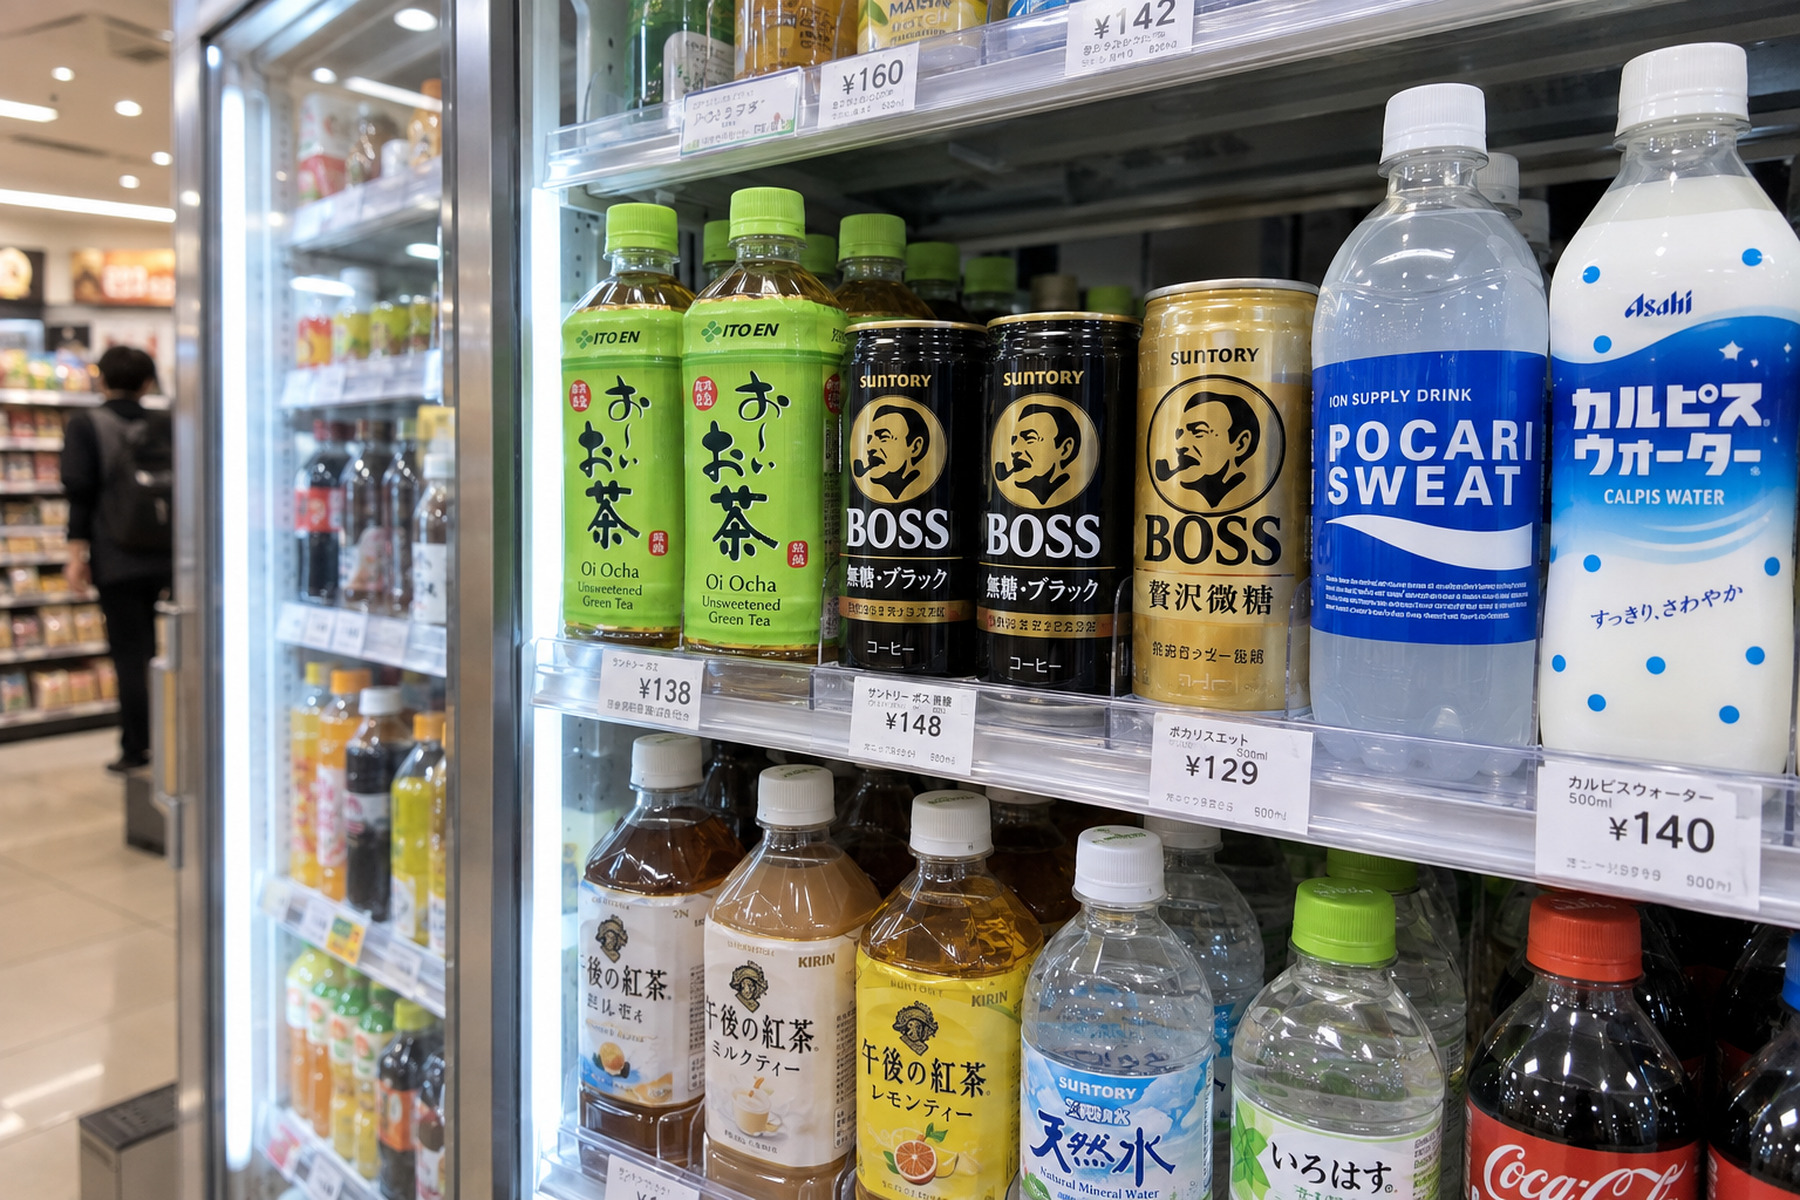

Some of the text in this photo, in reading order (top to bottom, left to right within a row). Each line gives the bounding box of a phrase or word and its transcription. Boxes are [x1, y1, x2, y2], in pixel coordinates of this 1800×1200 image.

[1094, 0, 1176, 39] ¥142
[842, 58, 904, 95] ¥160
[1624, 289, 1692, 318] Asahi
[593, 331, 640, 345] ITO EN
[723, 323, 779, 337] ITO EN
[1329, 388, 1472, 408] ION SUPPLY DRINK
[1572, 383, 1763, 430] カルピス
[1329, 419, 1533, 463] POCARI
[1574, 432, 1761, 476] ウォーター
[1327, 465, 1521, 506] SWEAT
[1603, 489, 1725, 505] CALPIS WATER
[846, 508, 949, 549] BOSS
[986, 513, 1101, 558] BOSS
[1143, 514, 1282, 567] BOSS
[581, 561, 639, 578] Oi Ocha
[706, 573, 777, 592] Oi Ocha
[582, 595, 633, 610] Green Tea
[702, 595, 781, 611] Unsweetened
[1148, 579, 1274, 616] 贅沢微糖
[1590, 584, 1743, 630] すっきり、さわやか
[708, 610, 771, 626] Green Tea
[867, 640, 915, 656] コーヒー
[1009, 656, 1062, 674] コーヒー
[639, 677, 691, 705] ¥138
[886, 711, 942, 737] ¥148
[1186, 754, 1259, 785] ¥129
[1569, 792, 1613, 808] 500ml
[1609, 811, 1715, 854] ¥140
[798, 953, 836, 968] KIRIN
[971, 991, 1008, 1008] KIRIN
[706, 995, 815, 1054] 午後の紅茶
[712, 1040, 800, 1077] ミルクティー
[861, 1038, 987, 1098] 午後の紅茶
[871, 1084, 973, 1122] レモンティー
[1029, 1109, 1176, 1188] 天然水
[1272, 1142, 1392, 1194] いろはす
[1078, 1182, 1122, 1199] Mineral
[1125, 1189, 1160, 1200] Water
